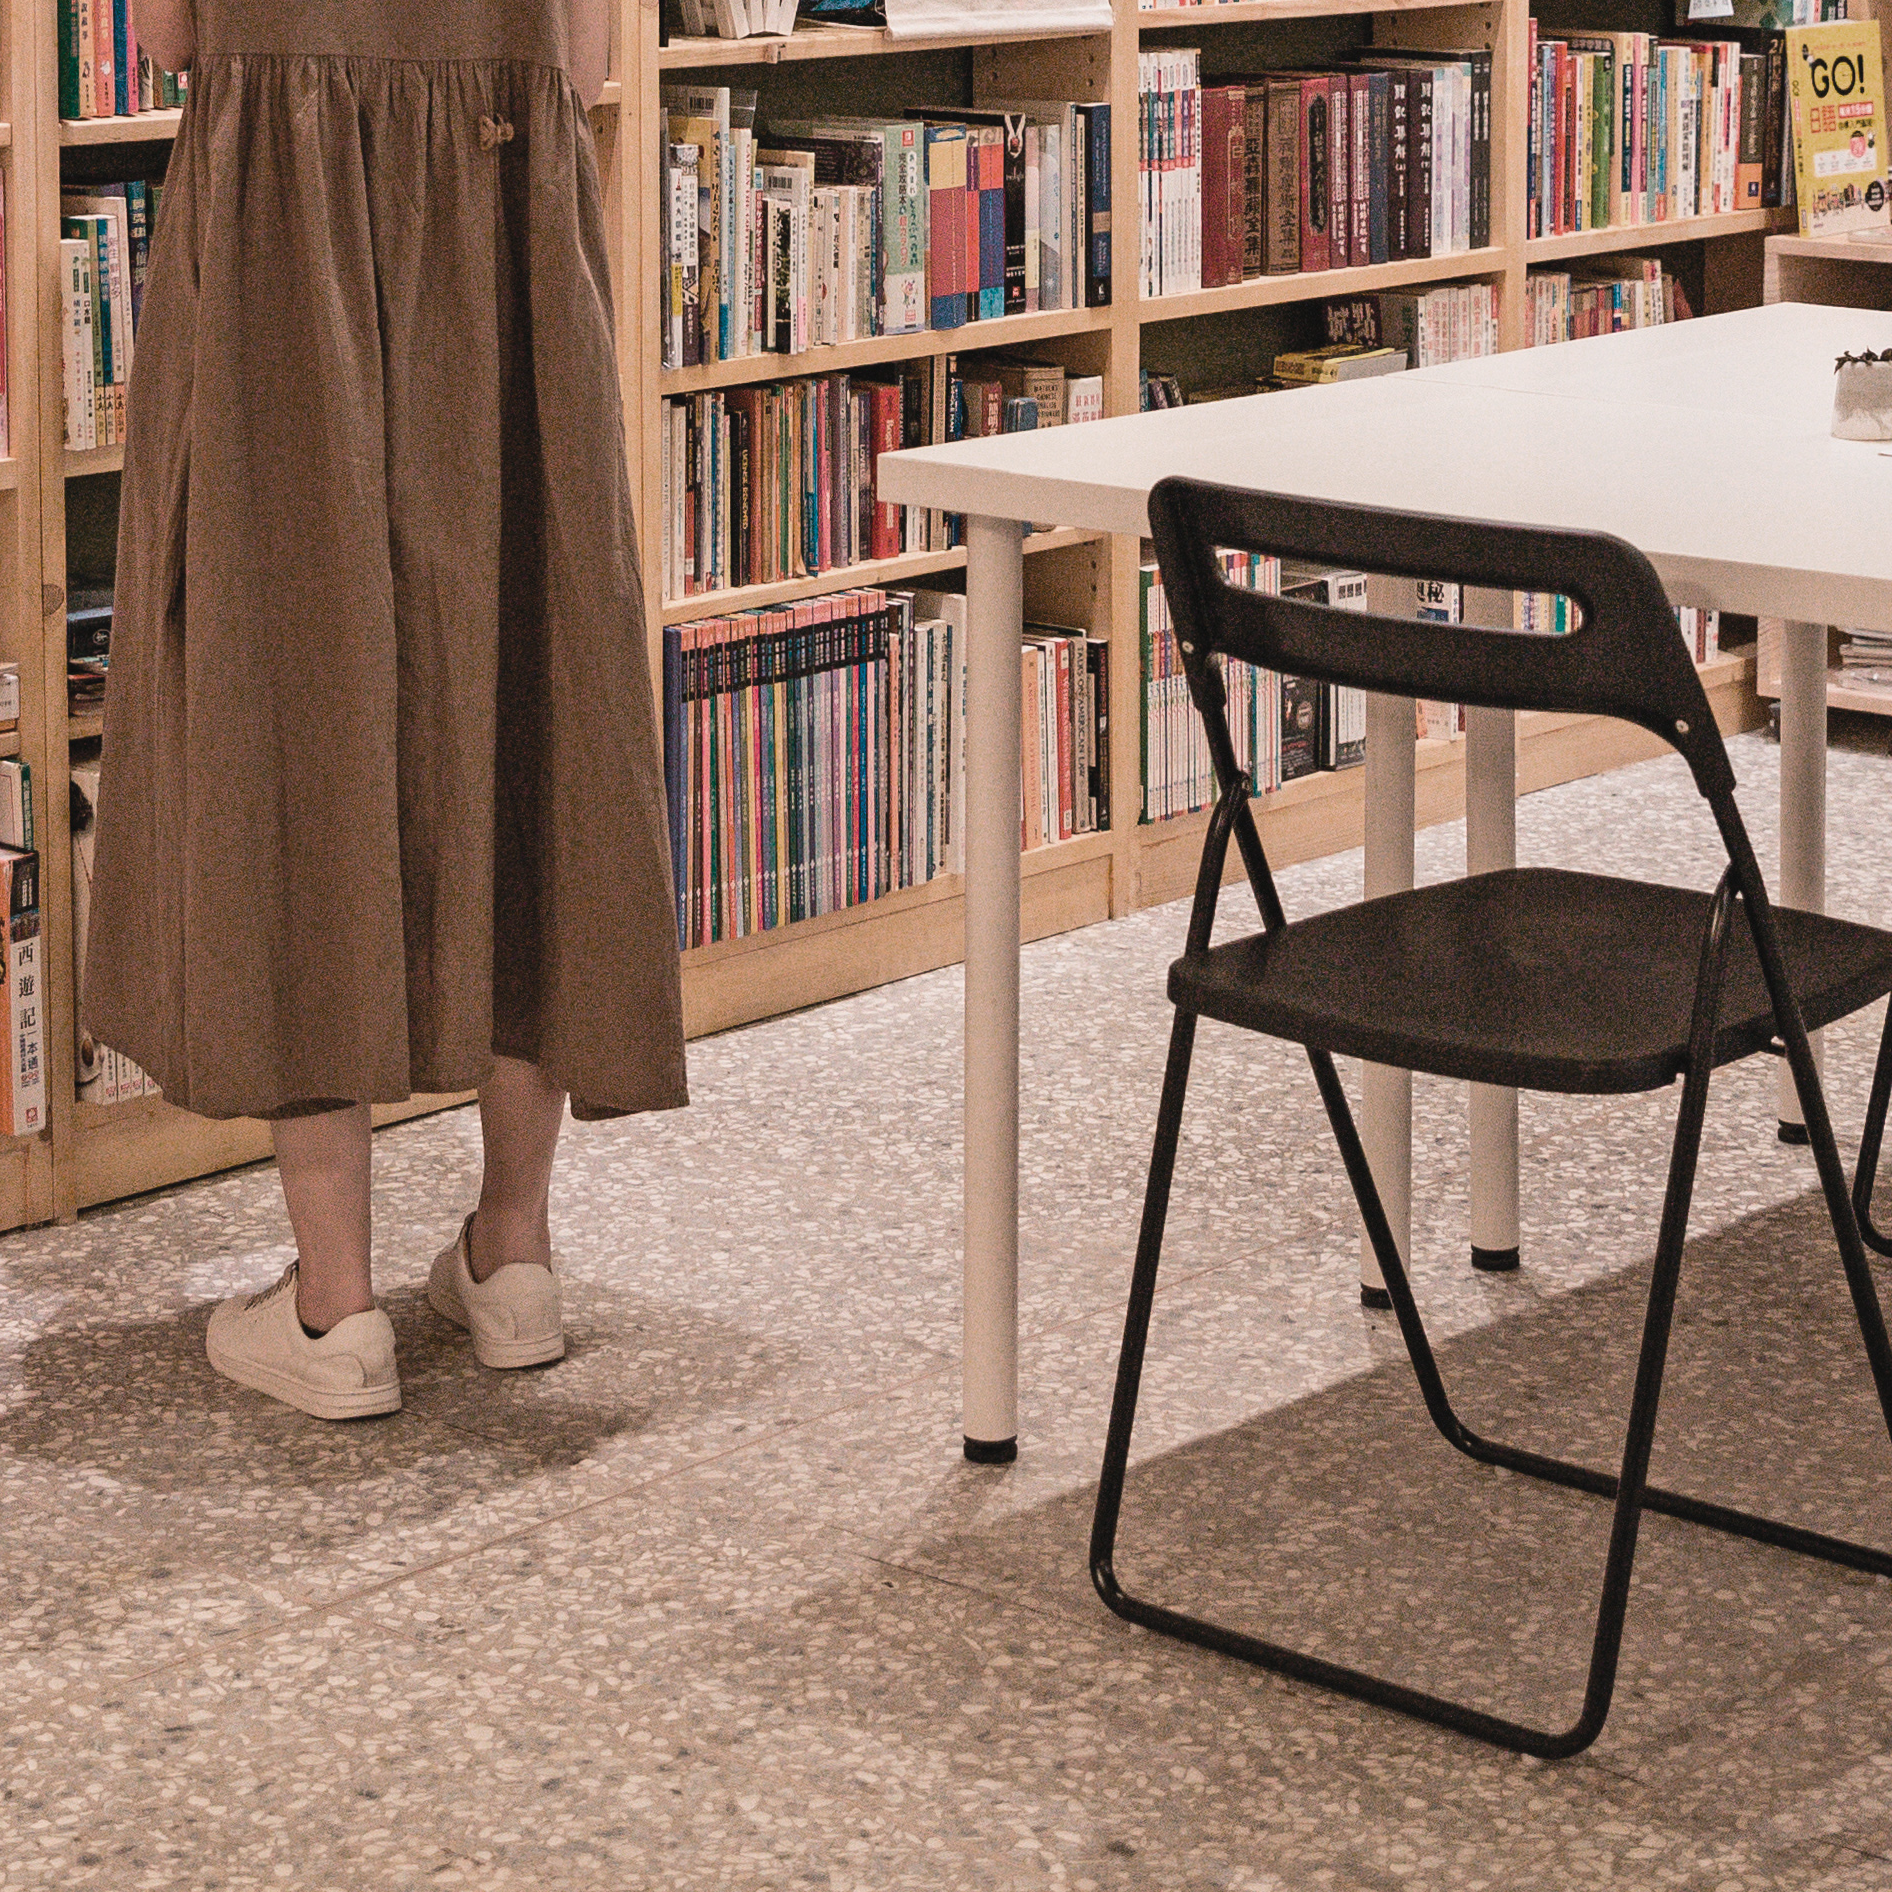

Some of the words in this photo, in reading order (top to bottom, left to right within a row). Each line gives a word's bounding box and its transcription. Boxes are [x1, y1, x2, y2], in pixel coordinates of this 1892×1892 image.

[1811, 54, 1866, 98] GO!
[17, 945, 38, 1032] 西遊記
